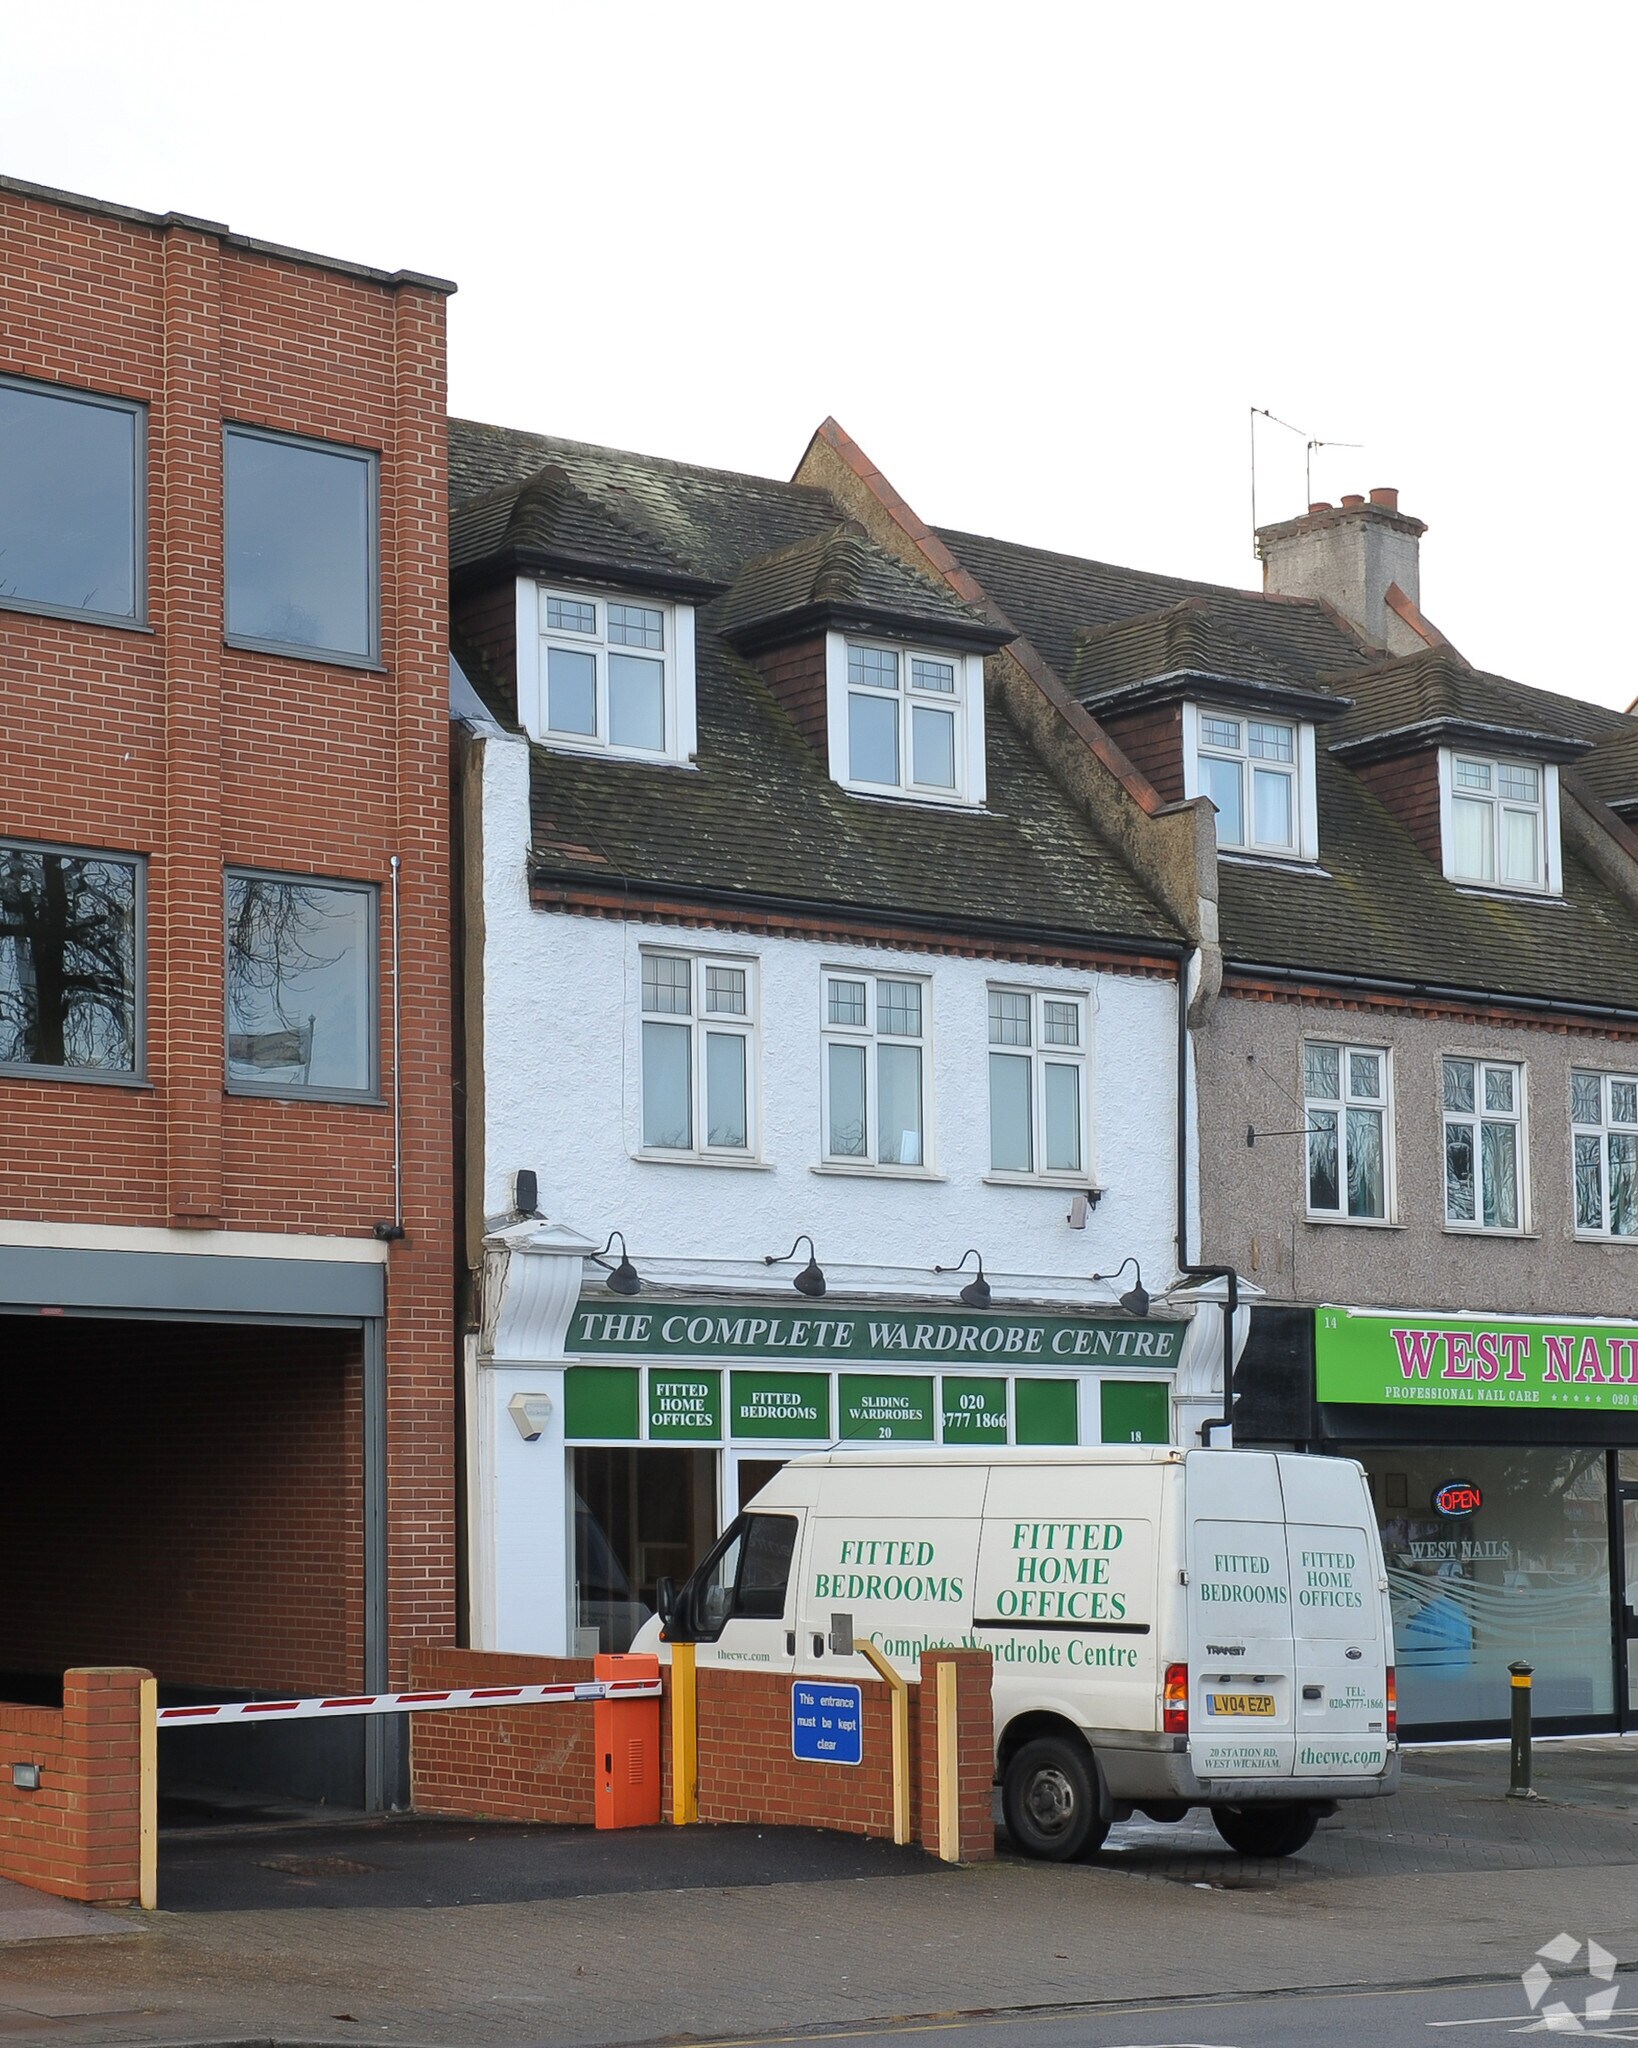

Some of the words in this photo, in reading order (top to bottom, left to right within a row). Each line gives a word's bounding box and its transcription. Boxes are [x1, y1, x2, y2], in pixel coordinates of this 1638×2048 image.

[1324, 1316, 1337, 1329] 14
[579, 1313, 652, 1341] THE
[661, 1316, 854, 1348] COMPLETE
[867, 1321, 1045, 1353] WARDROBE
[1052, 1329, 1174, 1357] CENTRE
[1390, 1328, 1530, 1382] WEST
[656, 1384, 708, 1397] FITTED
[1385, 1387, 1473, 1400] PROFESSIONAL
[1477, 1390, 1504, 1401] NAIL
[1509, 1391, 1540, 1402] CARE
[660, 1398, 704, 1411] HOME
[751, 1392, 801, 1405] FITTED
[861, 1397, 909, 1408] SLIDING
[960, 1394, 985, 1409] 020
[1612, 1393, 1630, 1405] 020
[651, 1412, 713, 1426] OFFICES
[740, 1405, 817, 1420] BEDROOMS
[849, 1409, 923, 1420] WARDROBES
[975, 1412, 1006, 1428] 1866
[878, 1427, 892, 1439] 20
[1130, 1431, 1142, 1442] 18
[1441, 1489, 1481, 1510] OPEN
[1011, 1523, 1123, 1551] FITTED
[839, 1540, 934, 1566] FITTED
[1409, 1541, 1457, 1559] WEST
[1461, 1540, 1510, 1558] NAILS
[1214, 1554, 1270, 1574] FITTED
[1301, 1551, 1355, 1569] FITTED
[1015, 1557, 1110, 1585] HOME
[1307, 1571, 1352, 1588] HOME
[814, 1574, 964, 1603] BEDROOMS
[1201, 1583, 1287, 1604] BEDROOMS
[997, 1589, 1126, 1620] OFFICES
[1299, 1590, 1362, 1608] OFFICES
[1068, 1640, 1137, 1667] Centre
[1345, 1686, 1365, 1697] TEL:
[799, 1693, 815, 1705] This
[820, 1696, 854, 1708] entrance
[1213, 1696, 1245, 1712] LV04
[1249, 1697, 1271, 1712] EZP
[797, 1717, 816, 1728] must
[822, 1717, 832, 1729] be
[838, 1718, 856, 1732] kept
[817, 1738, 837, 1750] clear
[1209, 1748, 1220, 1757] 20
[1220, 1748, 1261, 1757] STATION
[1301, 1747, 1381, 1765] thecwc.com
[1205, 1759, 1231, 1769] WEST
